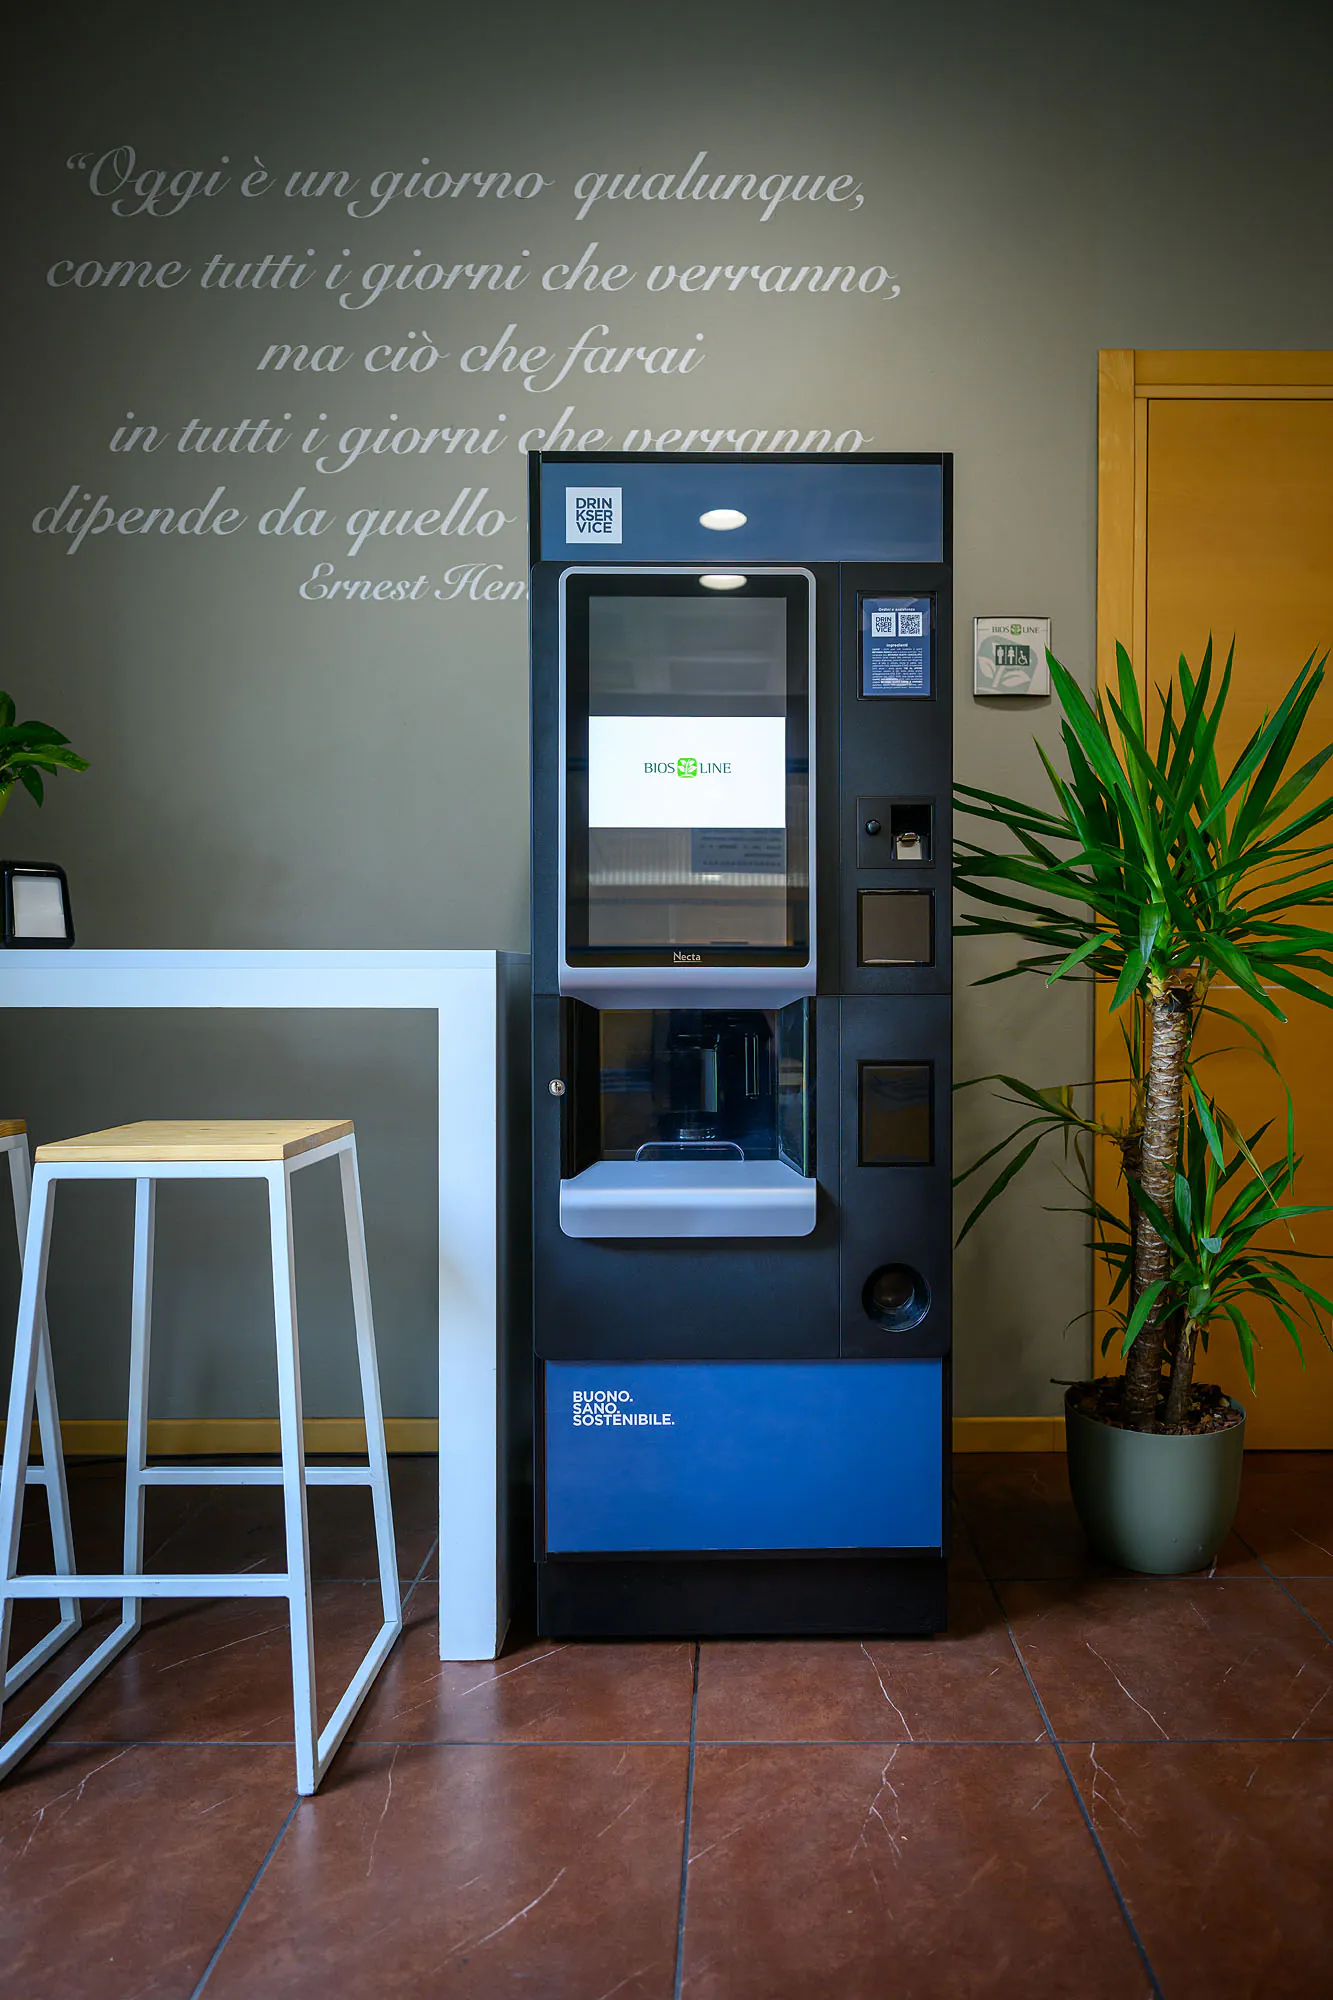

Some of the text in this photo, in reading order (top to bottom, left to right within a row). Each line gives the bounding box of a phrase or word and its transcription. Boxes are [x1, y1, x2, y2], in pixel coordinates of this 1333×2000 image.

[240, 155, 277, 198] è
[284, 170, 360, 198] un
[346, 157, 555, 219] giorno
[573, 151, 864, 222] qualunque,
[46, 242, 900, 311] come tutti i giorni che verranno,
[256, 324, 706, 393] ma ciò che farai
[109, 406, 875, 474] in tutti i giorni che verranno
[576, 498, 612, 509] DRIN
[32, 485, 518, 557] dipende da quello
[576, 510, 613, 521] KSER
[576, 522, 612, 533] VICE
[299, 562, 429, 601] Ernest
[1022, 626, 1040, 634] LINE
[644, 762, 731, 774] BIOS LINE
[673, 952, 701, 961] Necta
[573, 1390, 634, 1402] BUONO.
[573, 1402, 621, 1415] SANO.
[573, 1414, 675, 1426] SOSTENIBILE.
